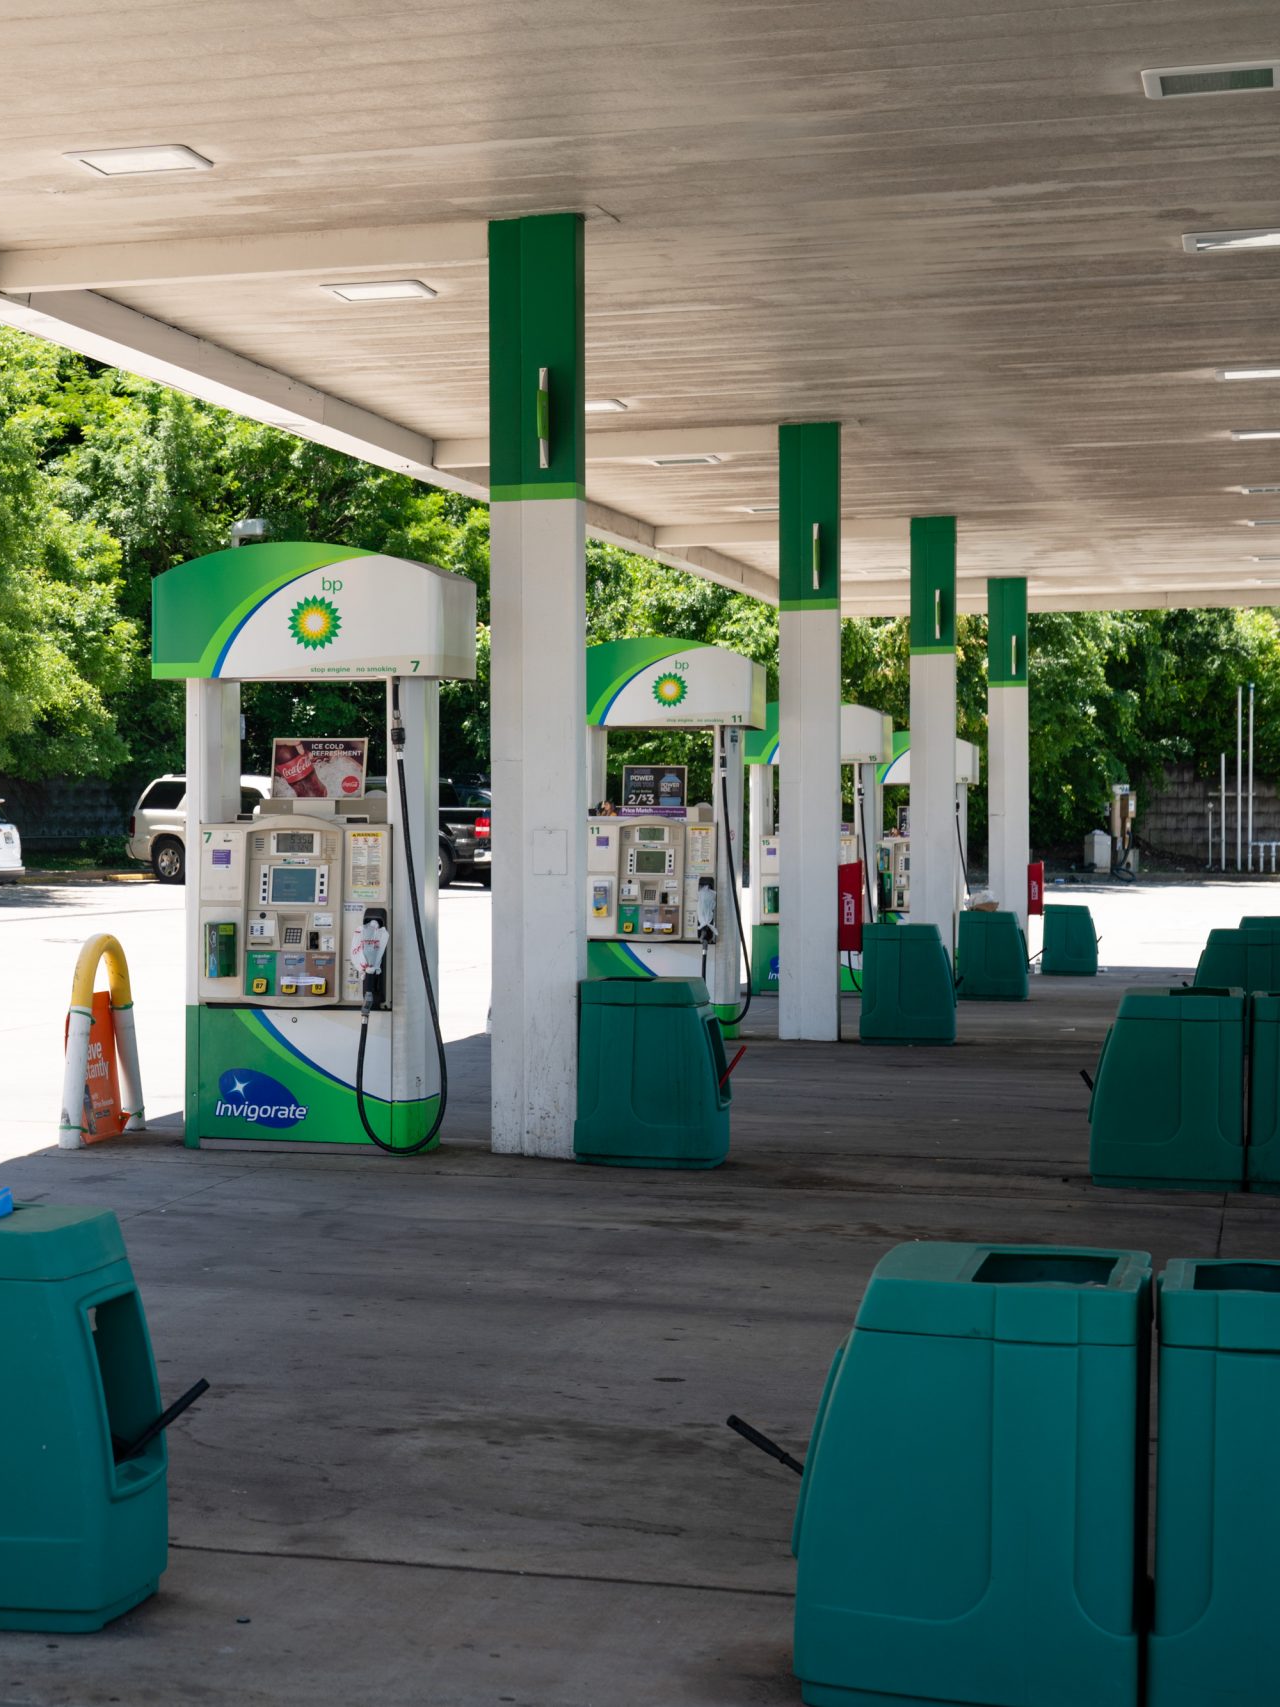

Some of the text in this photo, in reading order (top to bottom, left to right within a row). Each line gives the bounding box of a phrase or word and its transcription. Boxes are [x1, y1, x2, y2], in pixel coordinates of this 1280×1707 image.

[321, 577, 343, 594] bp
[410, 660, 420, 672] 7
[674, 660, 689, 671] bp
[731, 715, 743, 723] 11
[628, 793, 655, 805] 2/$3
[590, 826, 600, 834] 11
[203, 832, 212, 843] 7
[86, 1042, 103, 1062] ave
[85, 1058, 109, 1080] stantly
[215, 1100, 307, 1122] Invigorate
